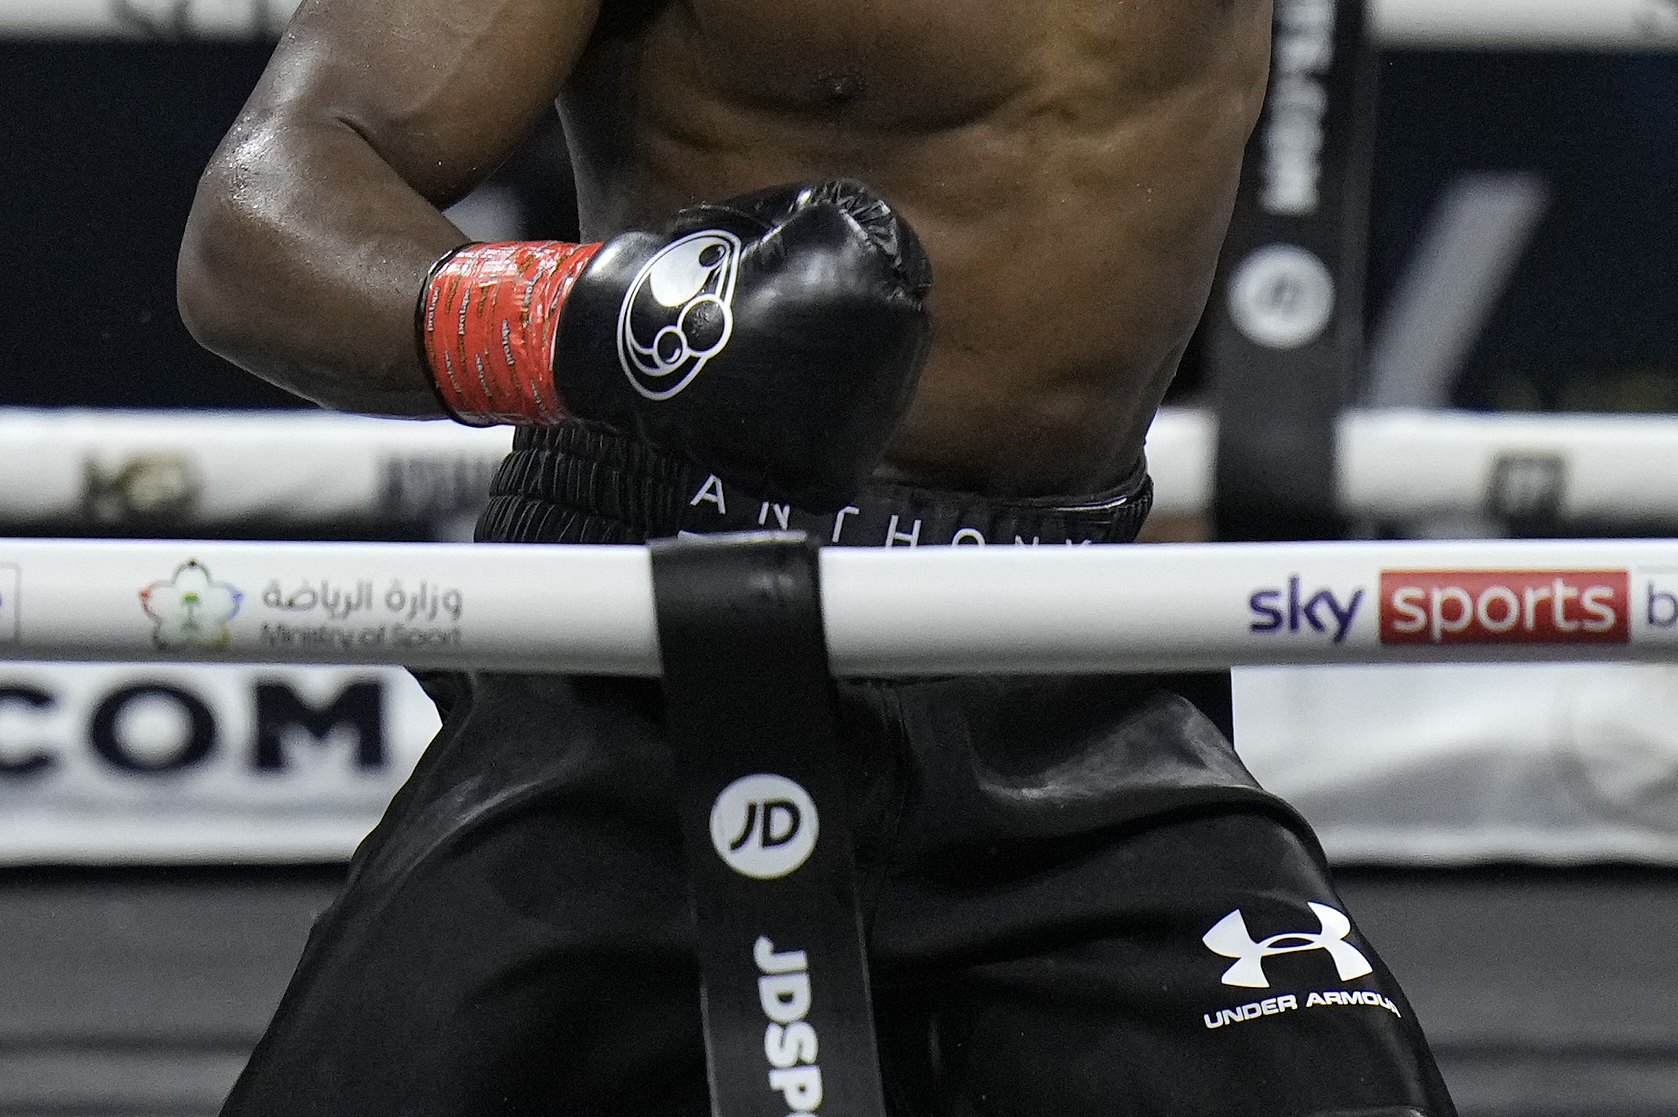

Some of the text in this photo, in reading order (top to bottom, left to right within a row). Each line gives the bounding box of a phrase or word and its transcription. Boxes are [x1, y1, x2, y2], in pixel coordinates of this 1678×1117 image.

[385, 578, 463, 622] وزارة
[1247, 574, 1366, 644] sky
[1391, 575, 1618, 644] sports
[730, 800, 802, 855] JD
[753, 934, 824, 1117] JDSP
[1203, 993, 1299, 1029] UNDER
